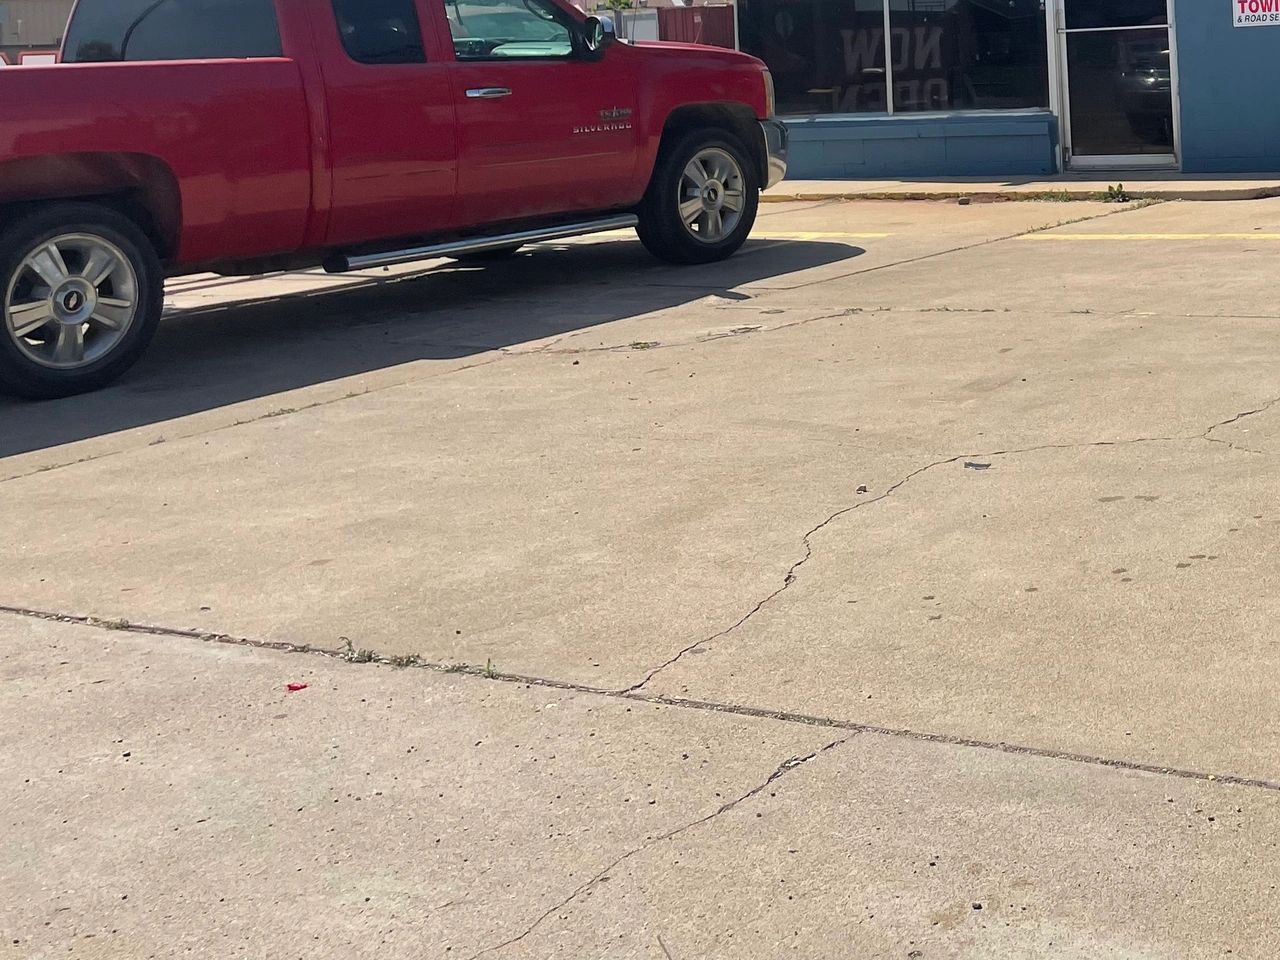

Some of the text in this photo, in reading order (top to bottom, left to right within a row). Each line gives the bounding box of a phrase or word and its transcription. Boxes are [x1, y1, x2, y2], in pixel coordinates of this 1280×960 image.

[1237, 15, 1242, 23] &
[1244, 14, 1268, 23] ROAD
[573, 122, 632, 134] SILVERADO
